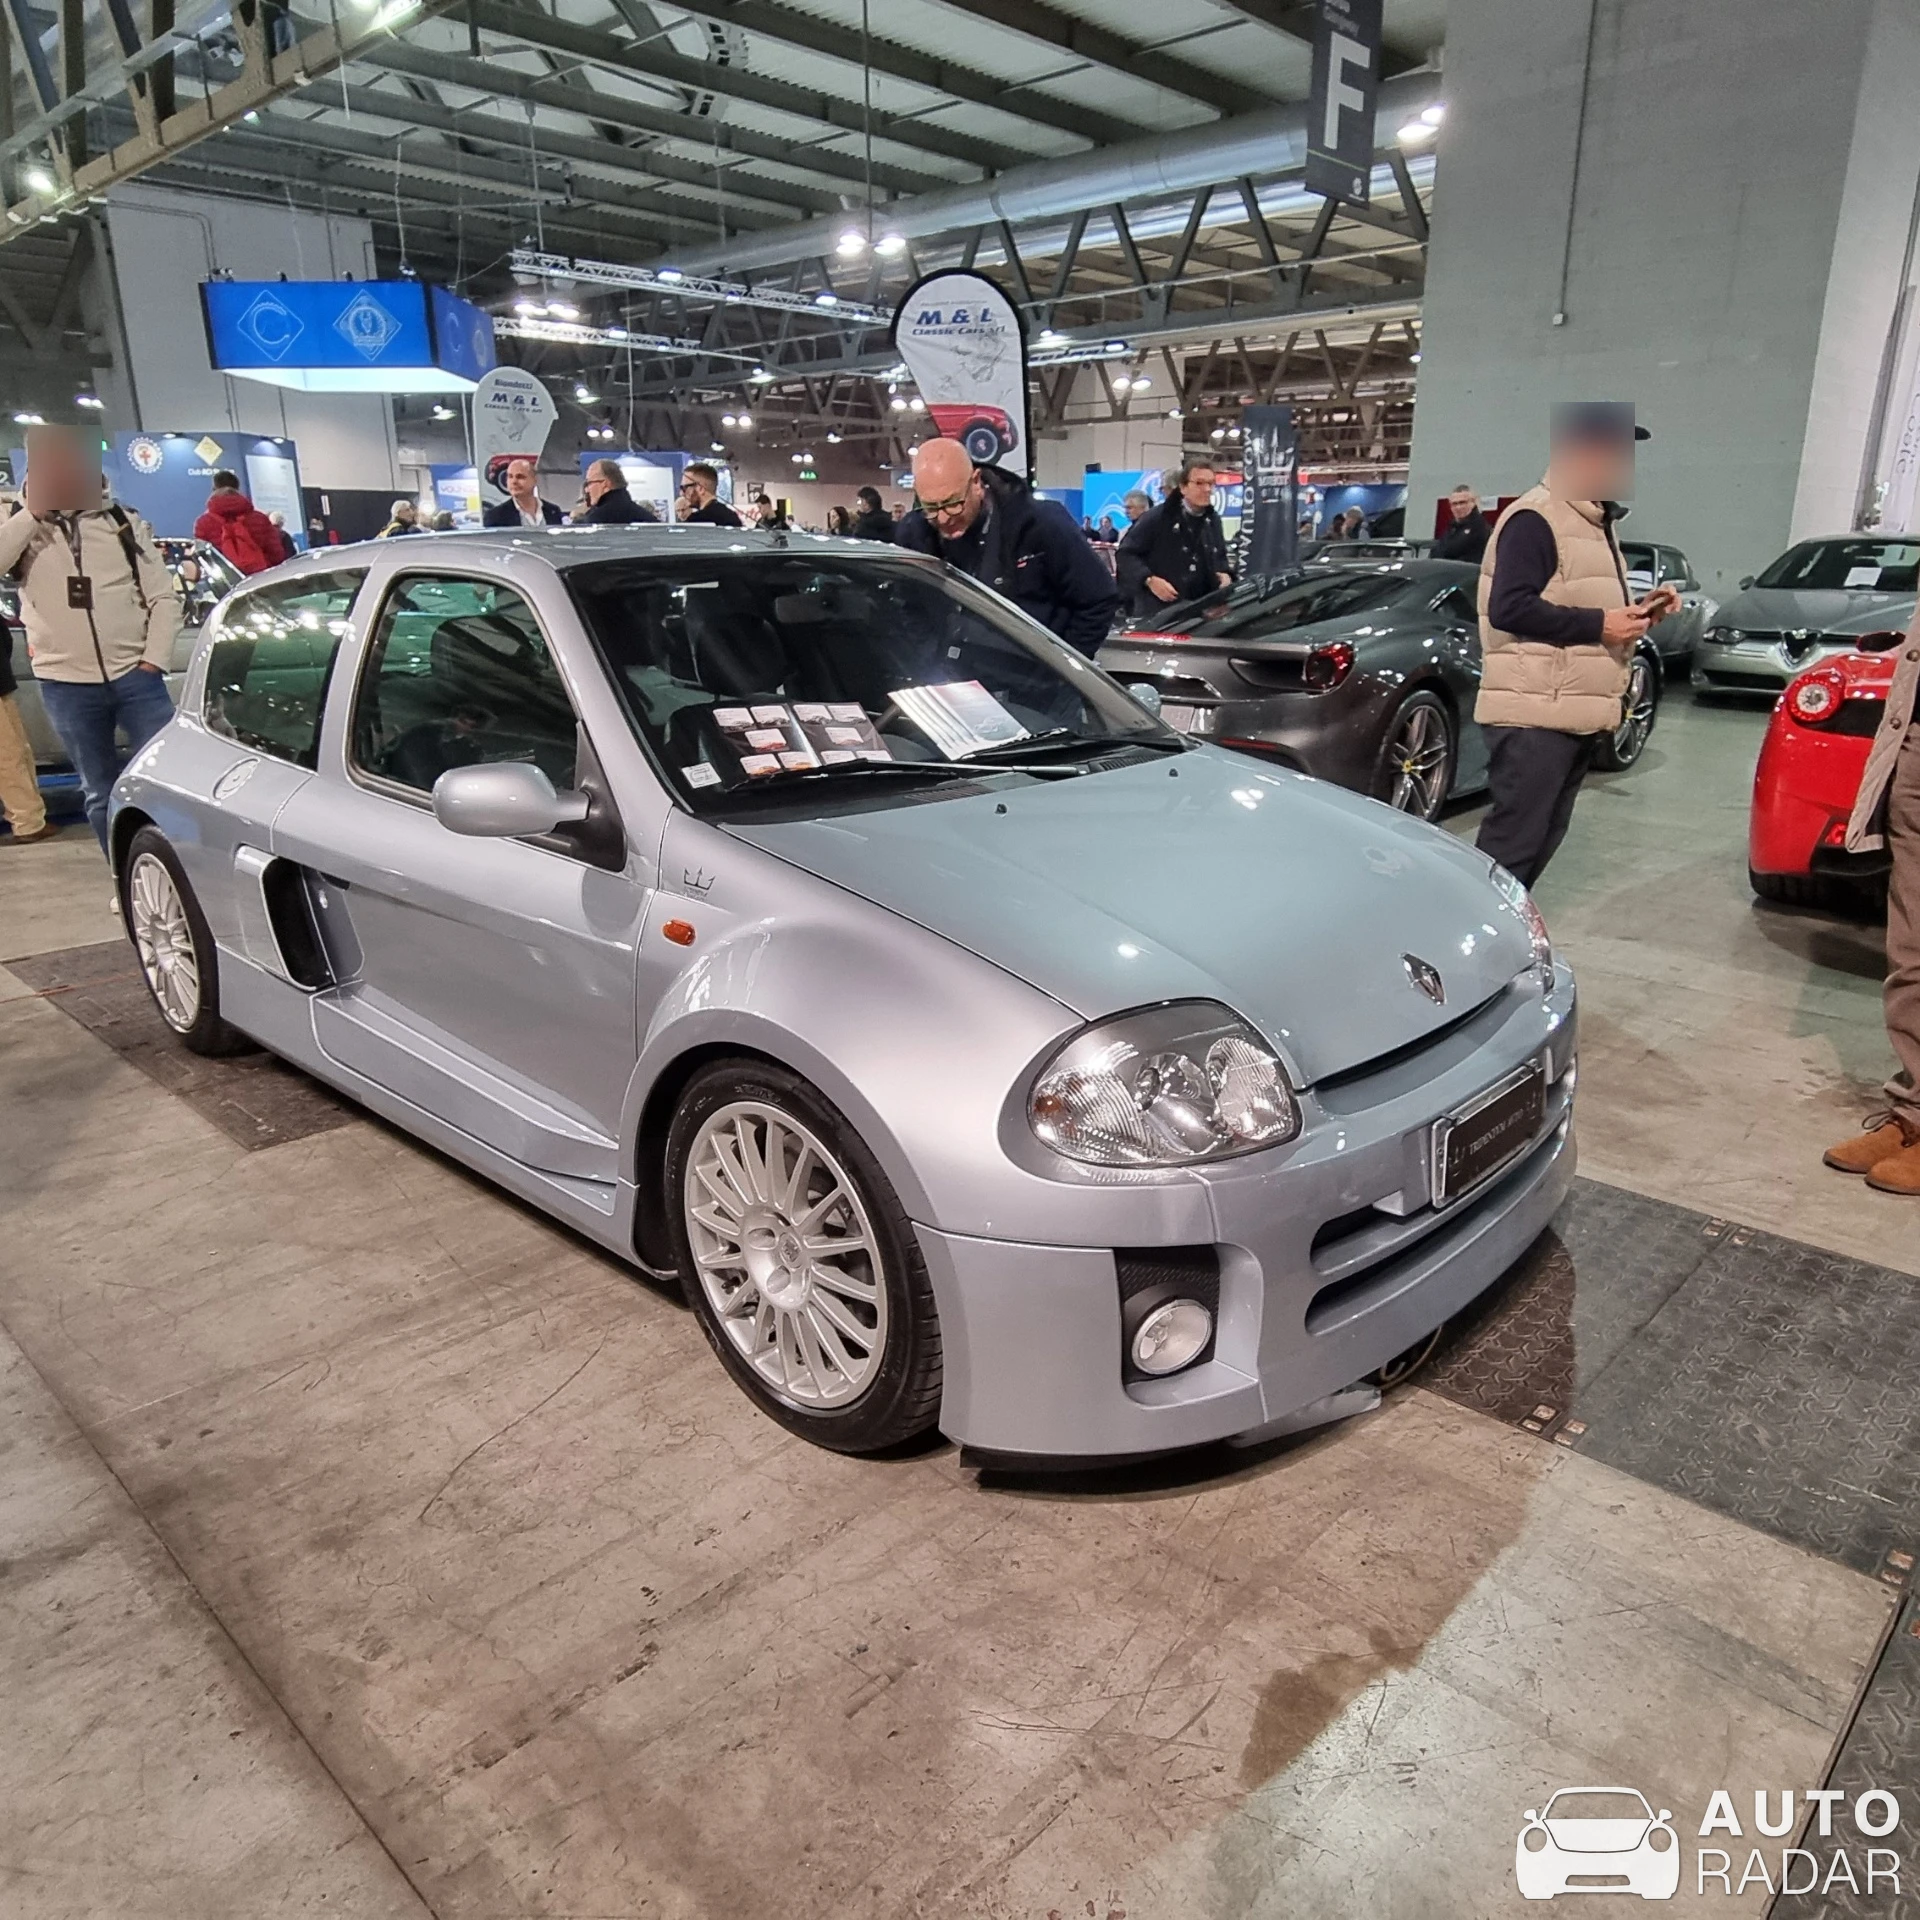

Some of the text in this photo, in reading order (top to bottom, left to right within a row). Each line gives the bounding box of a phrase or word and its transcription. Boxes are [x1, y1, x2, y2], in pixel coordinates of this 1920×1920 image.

[1324, 31, 1370, 149] F
[916, 307, 992, 325] M & L
[958, 327, 985, 335] Cars
[492, 393, 539, 406] M & L
